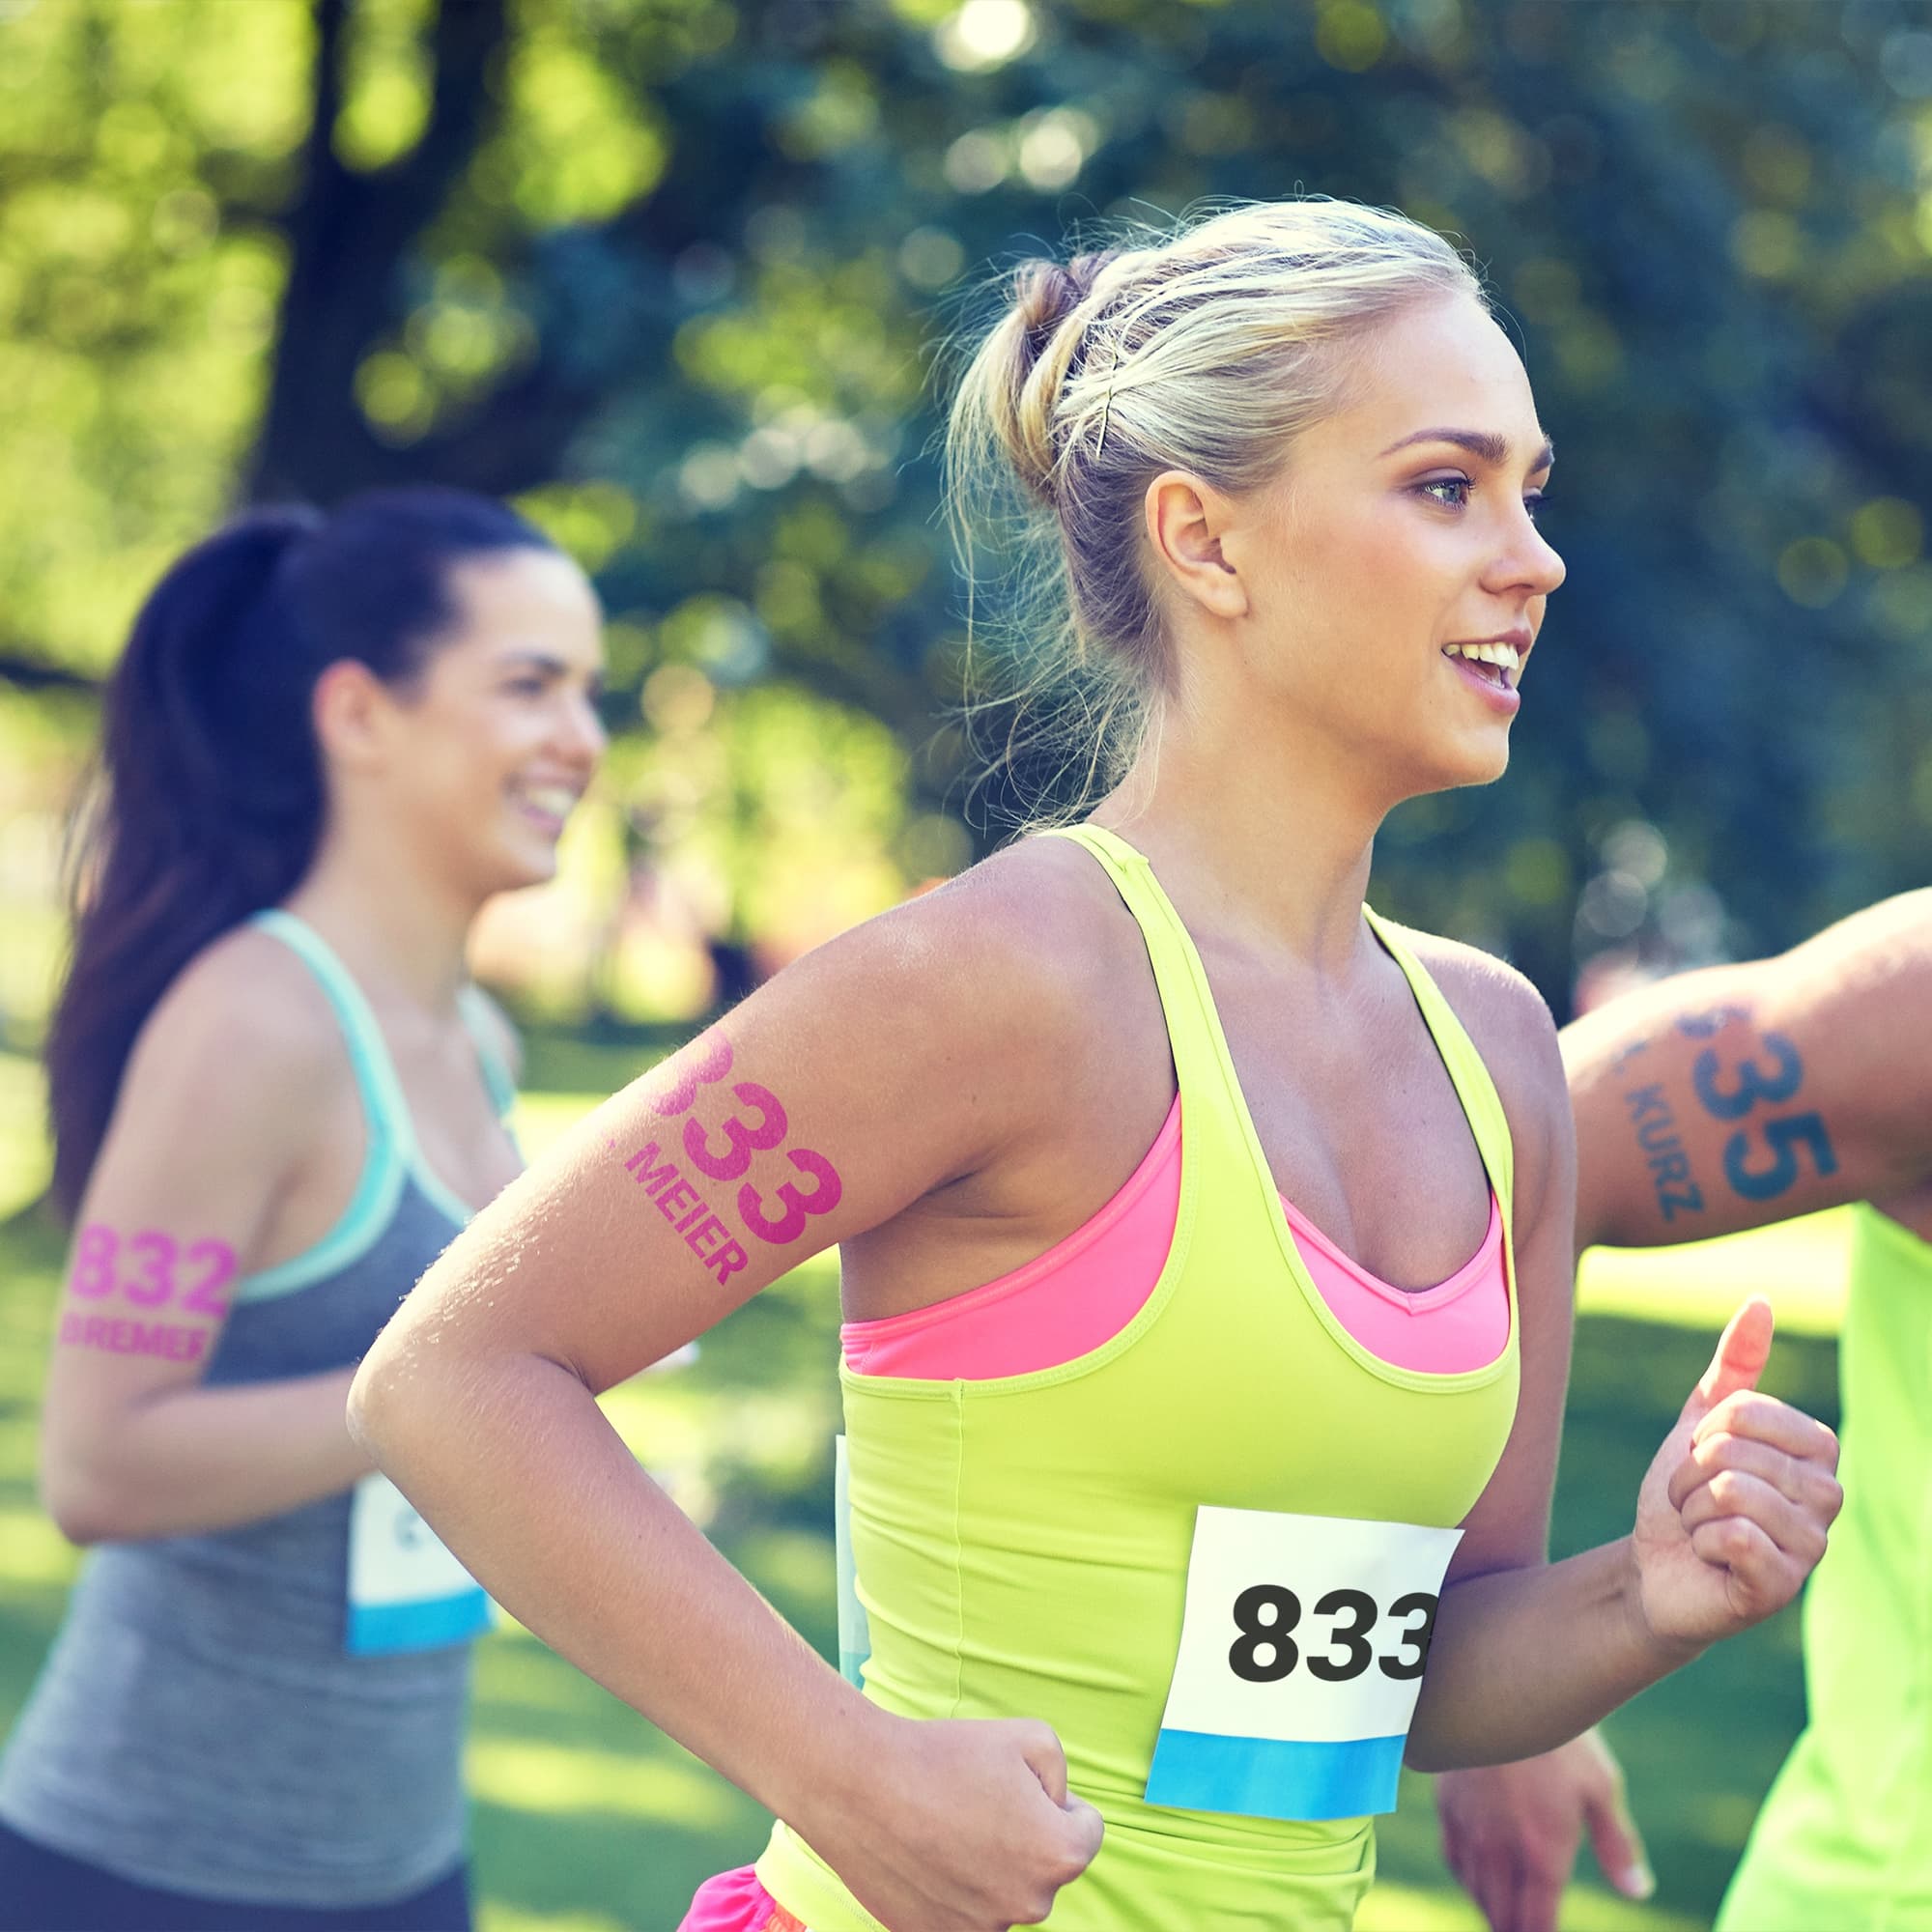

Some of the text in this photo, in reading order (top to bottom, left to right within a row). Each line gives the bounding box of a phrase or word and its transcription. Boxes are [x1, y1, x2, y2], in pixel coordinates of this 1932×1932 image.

[1625, 1083, 1706, 1223] KURZ
[1675, 1005, 1839, 1202] 35
[71, 1222, 237, 1321] 832
[625, 1141, 749, 1286] MEIER
[1229, 1584, 1439, 1683] 833
